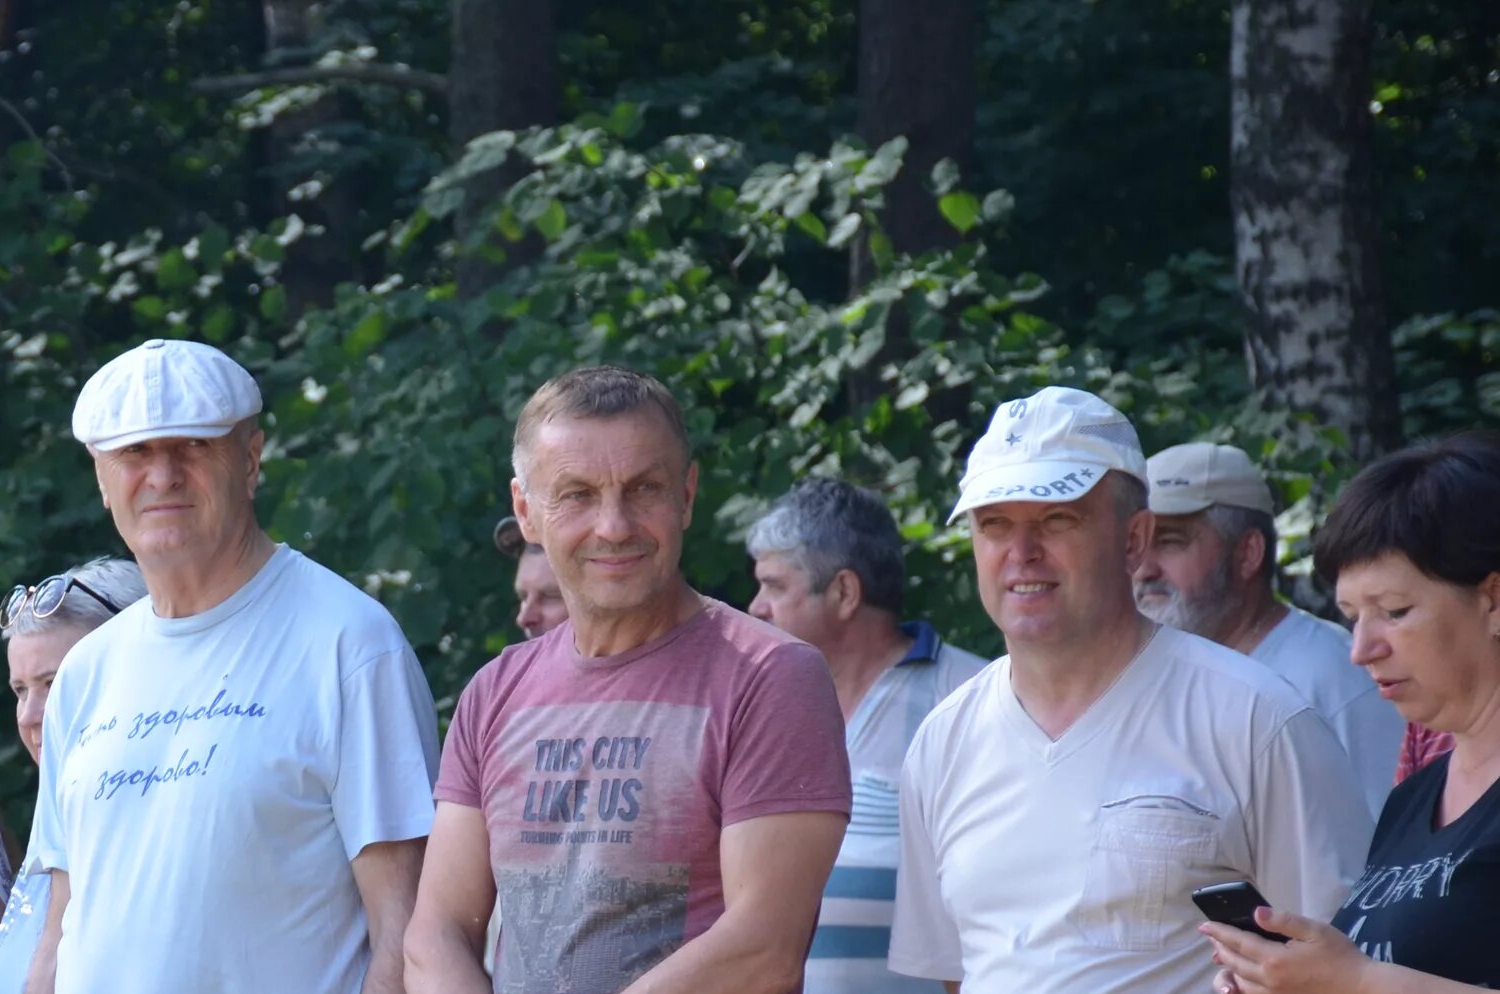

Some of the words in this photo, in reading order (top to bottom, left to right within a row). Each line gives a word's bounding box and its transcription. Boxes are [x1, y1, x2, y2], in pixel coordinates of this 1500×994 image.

[534, 737, 587, 772] THIS
[591, 736, 653, 770] CITY
[522, 779, 590, 823] LIKE
[597, 778, 643, 822] US
[597, 830, 609, 843] IN
[610, 830, 634, 844] LIFE
